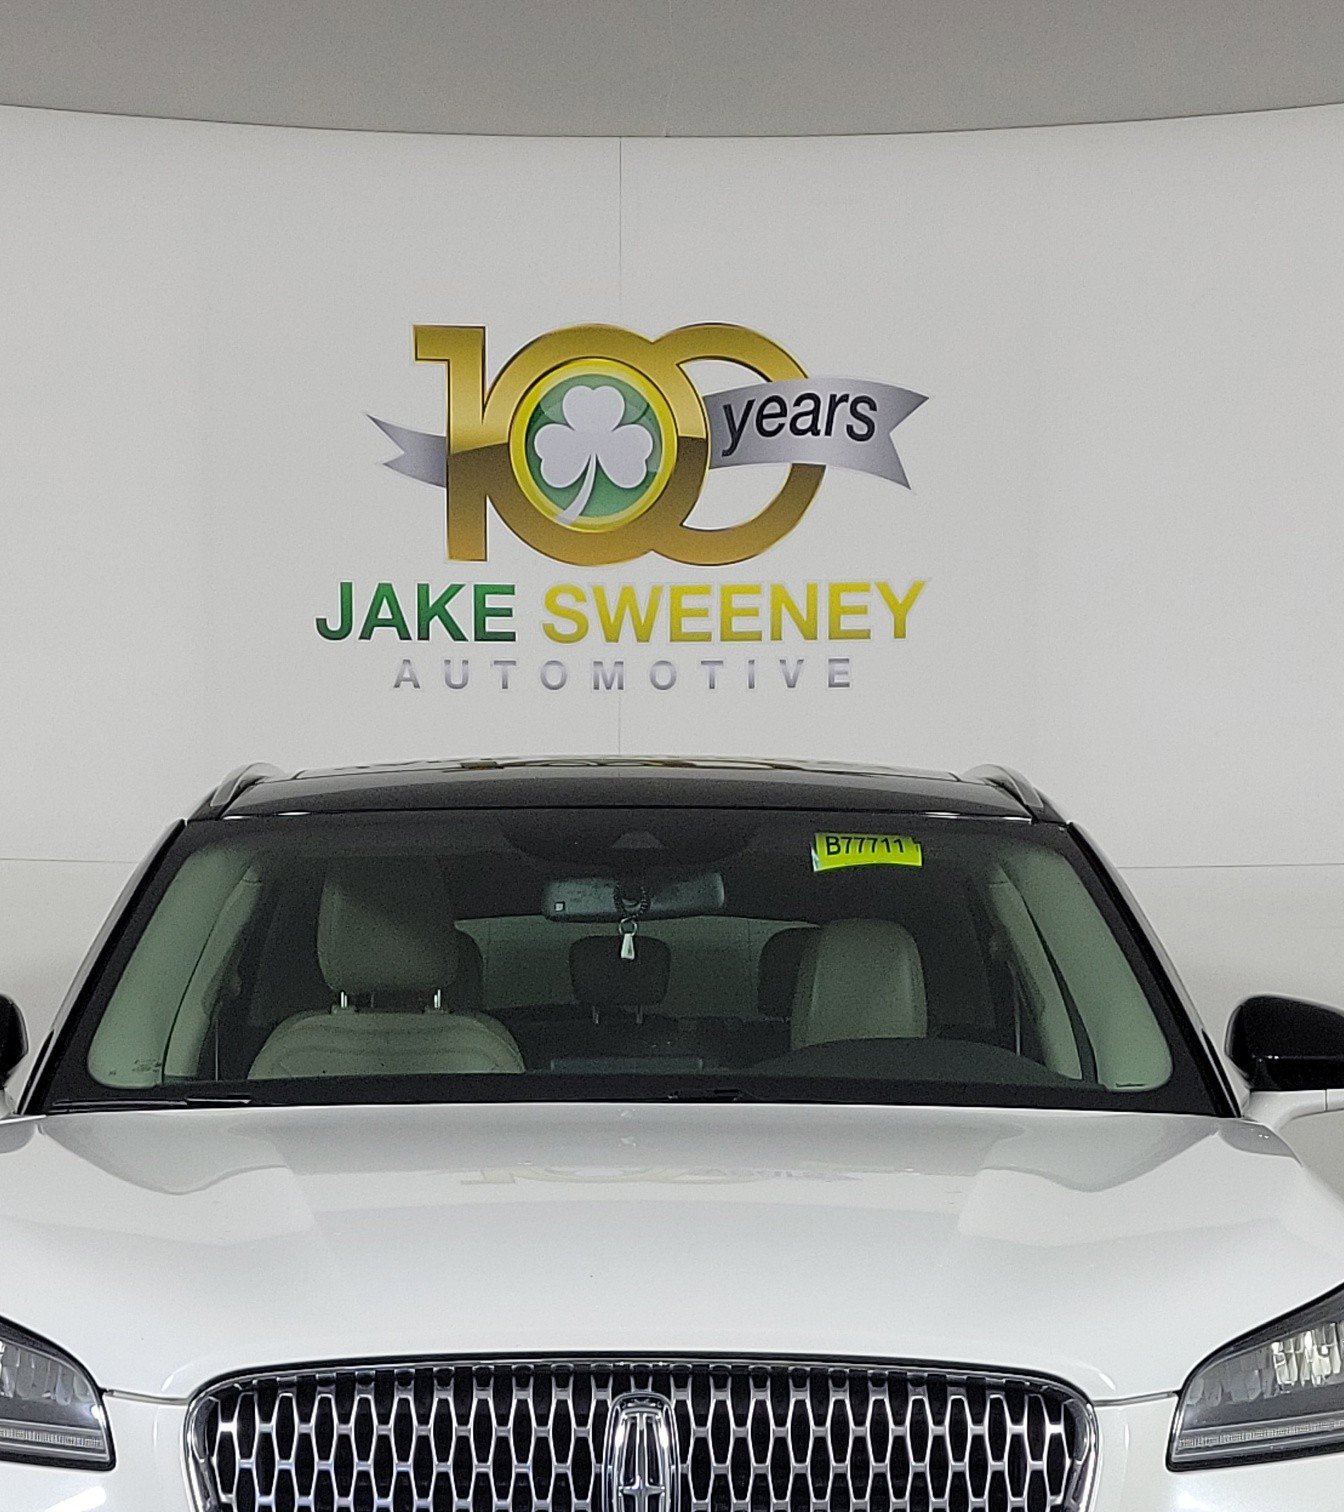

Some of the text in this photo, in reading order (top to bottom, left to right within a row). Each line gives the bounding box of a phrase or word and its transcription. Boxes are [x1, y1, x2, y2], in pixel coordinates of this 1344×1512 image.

[413, 322, 878, 567] 100 years
[316, 581, 925, 643] JAKE SWEENEY
[393, 658, 851, 690] AUTOMOTIVE
[826, 836, 904, 855] B77711
